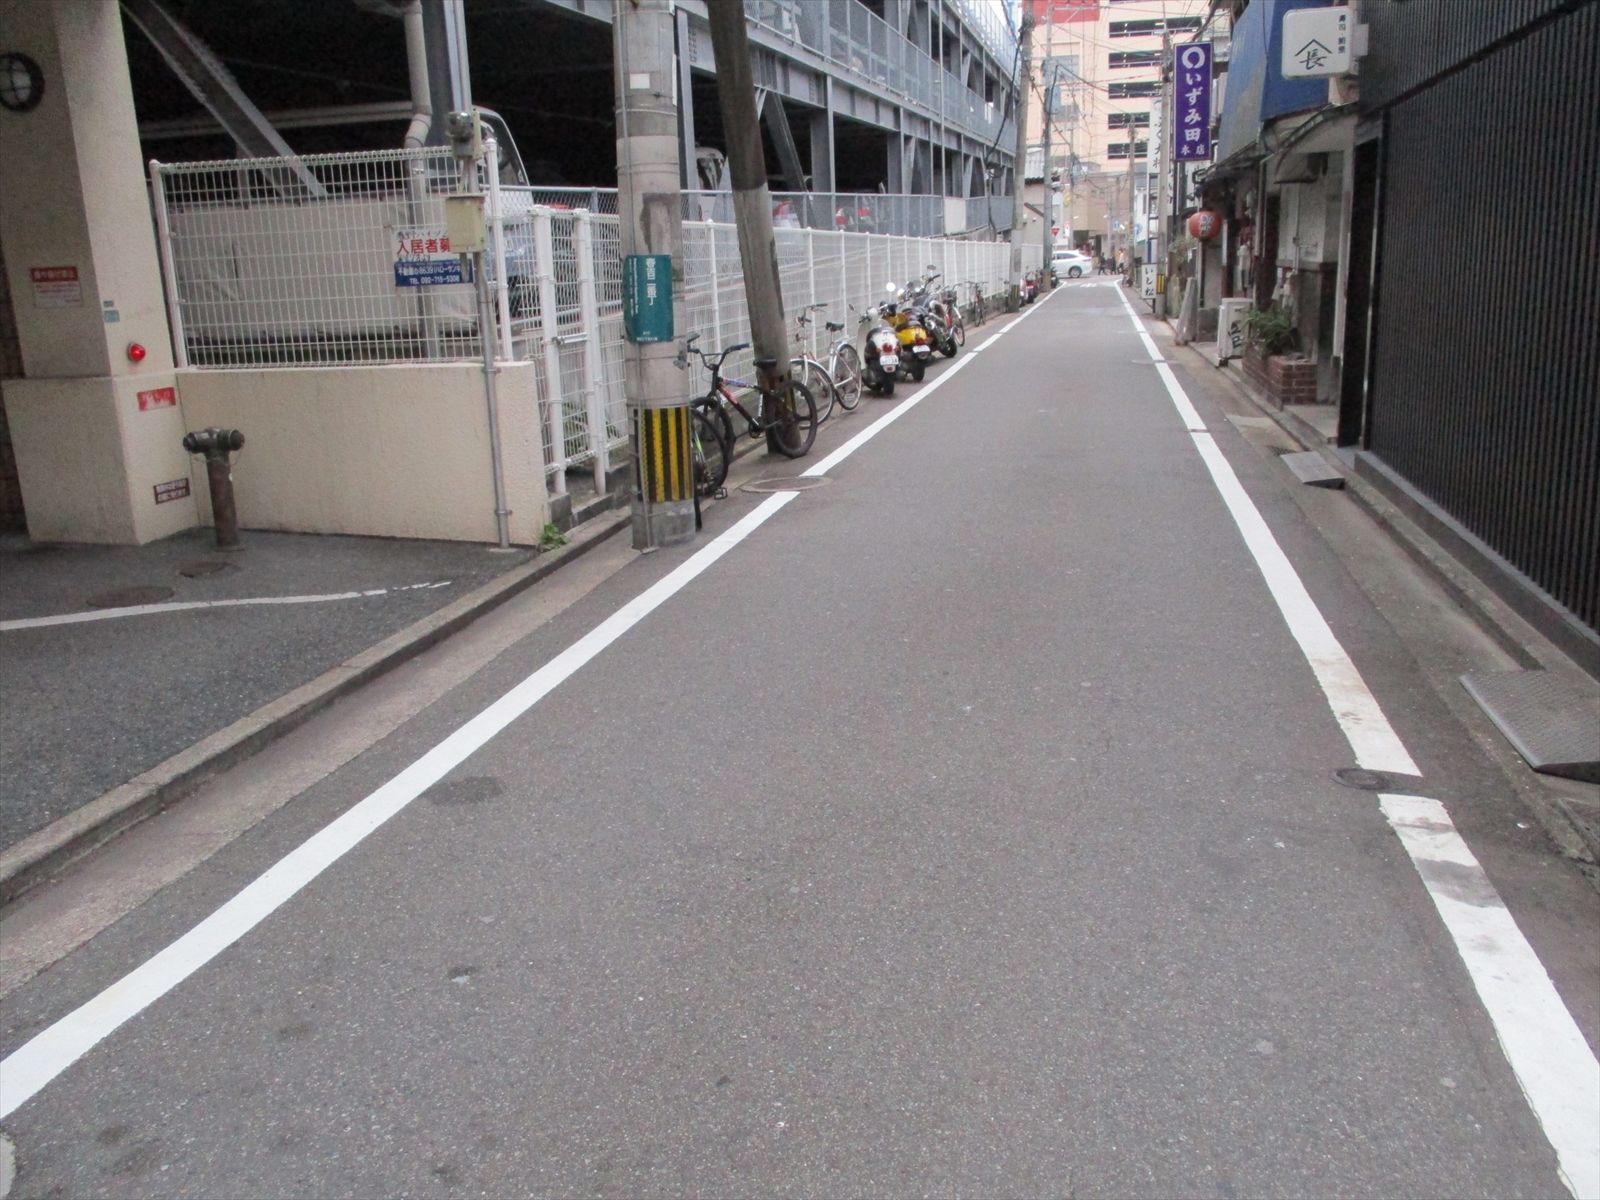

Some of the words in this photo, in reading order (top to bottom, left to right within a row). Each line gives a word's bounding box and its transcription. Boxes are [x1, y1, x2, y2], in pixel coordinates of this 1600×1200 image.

[1299, 48, 1328, 70] 長
[1184, 72, 1203, 142] いずみ田
[397, 238, 450, 255] 入居者募
